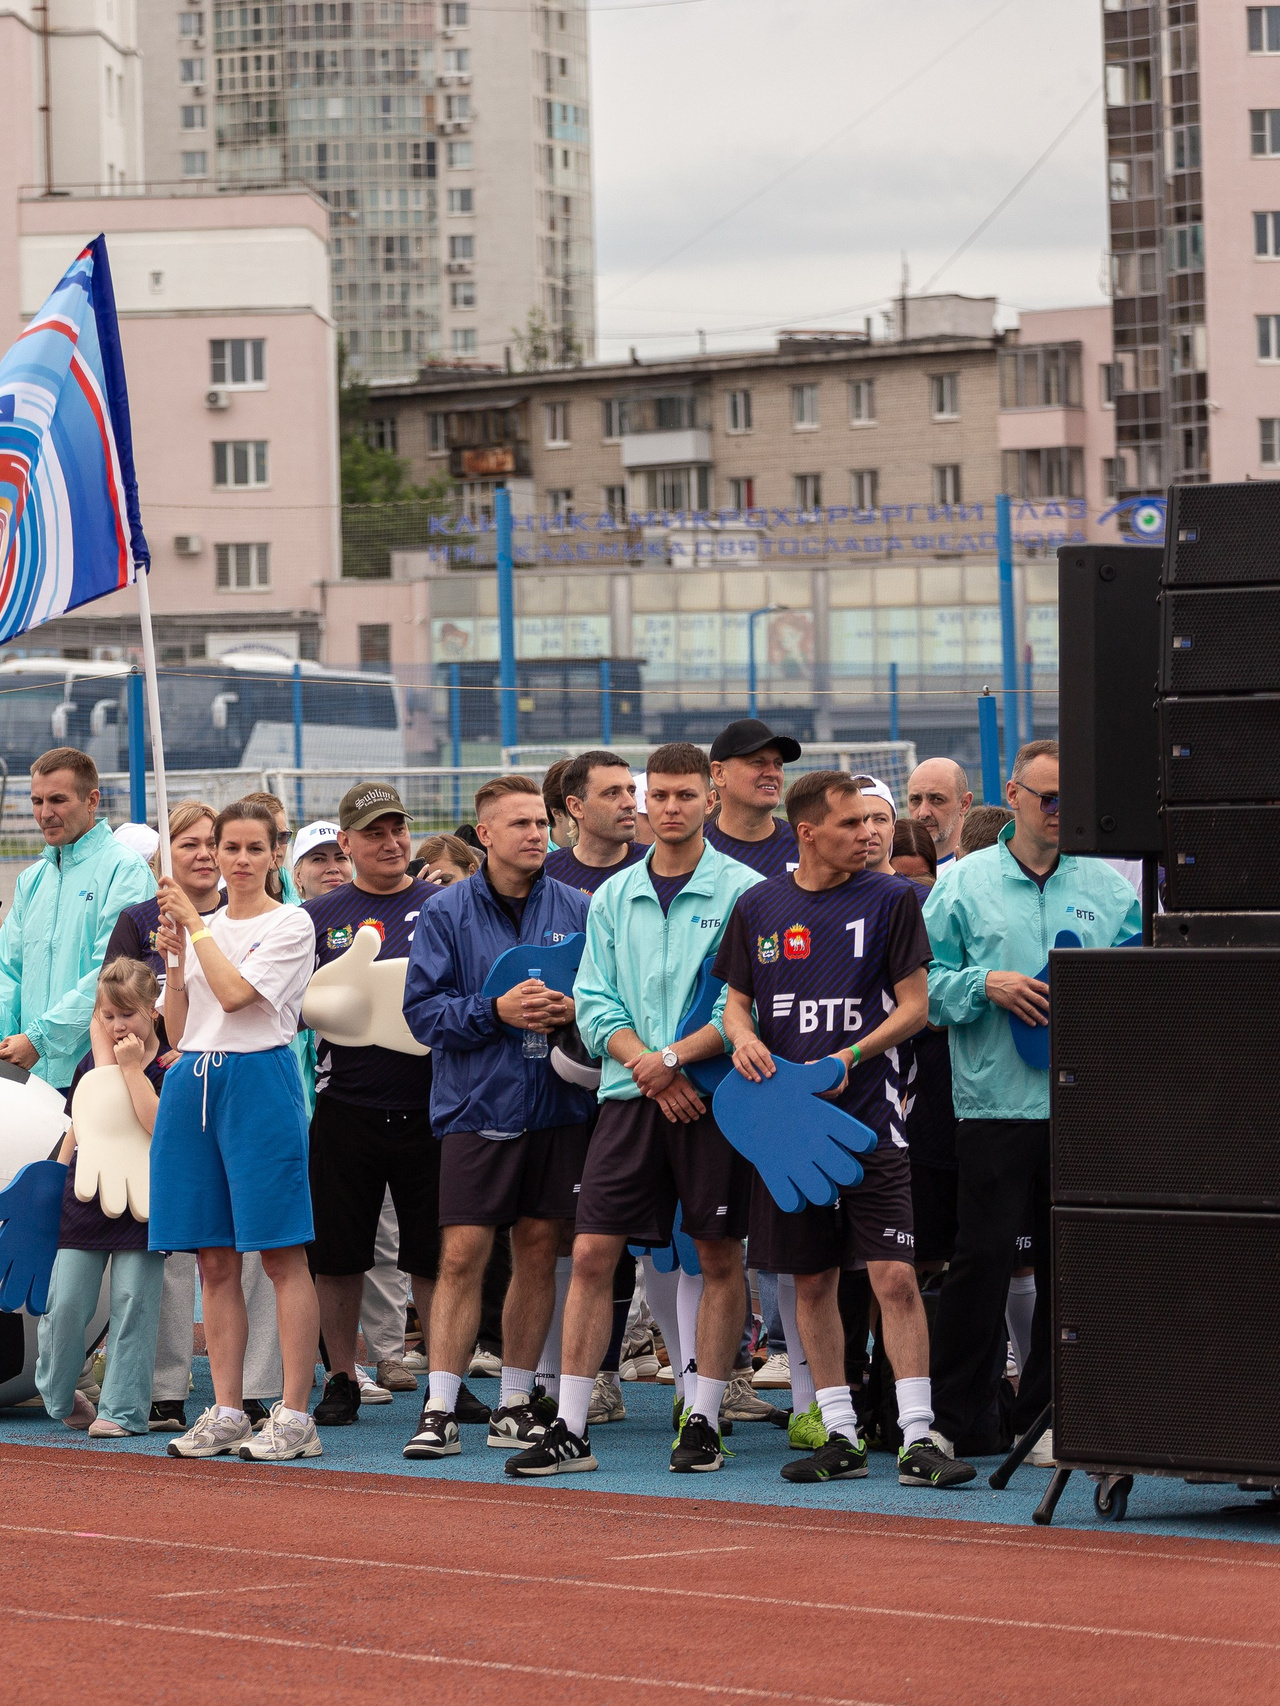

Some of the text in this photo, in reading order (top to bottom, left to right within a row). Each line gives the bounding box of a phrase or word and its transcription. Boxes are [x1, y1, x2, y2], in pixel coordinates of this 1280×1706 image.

[629, 502, 984, 531] МИКРОХИРУРГИИ
[510, 541, 684, 562] КАДЕМИКА
[694, 535, 904, 559] СВЯТОСЛАВА
[700, 918, 721, 929] ВТБ
[1076, 908, 1095, 921] ВТБ
[845, 918, 865, 958] 1
[799, 998, 863, 1034] ВТБ
